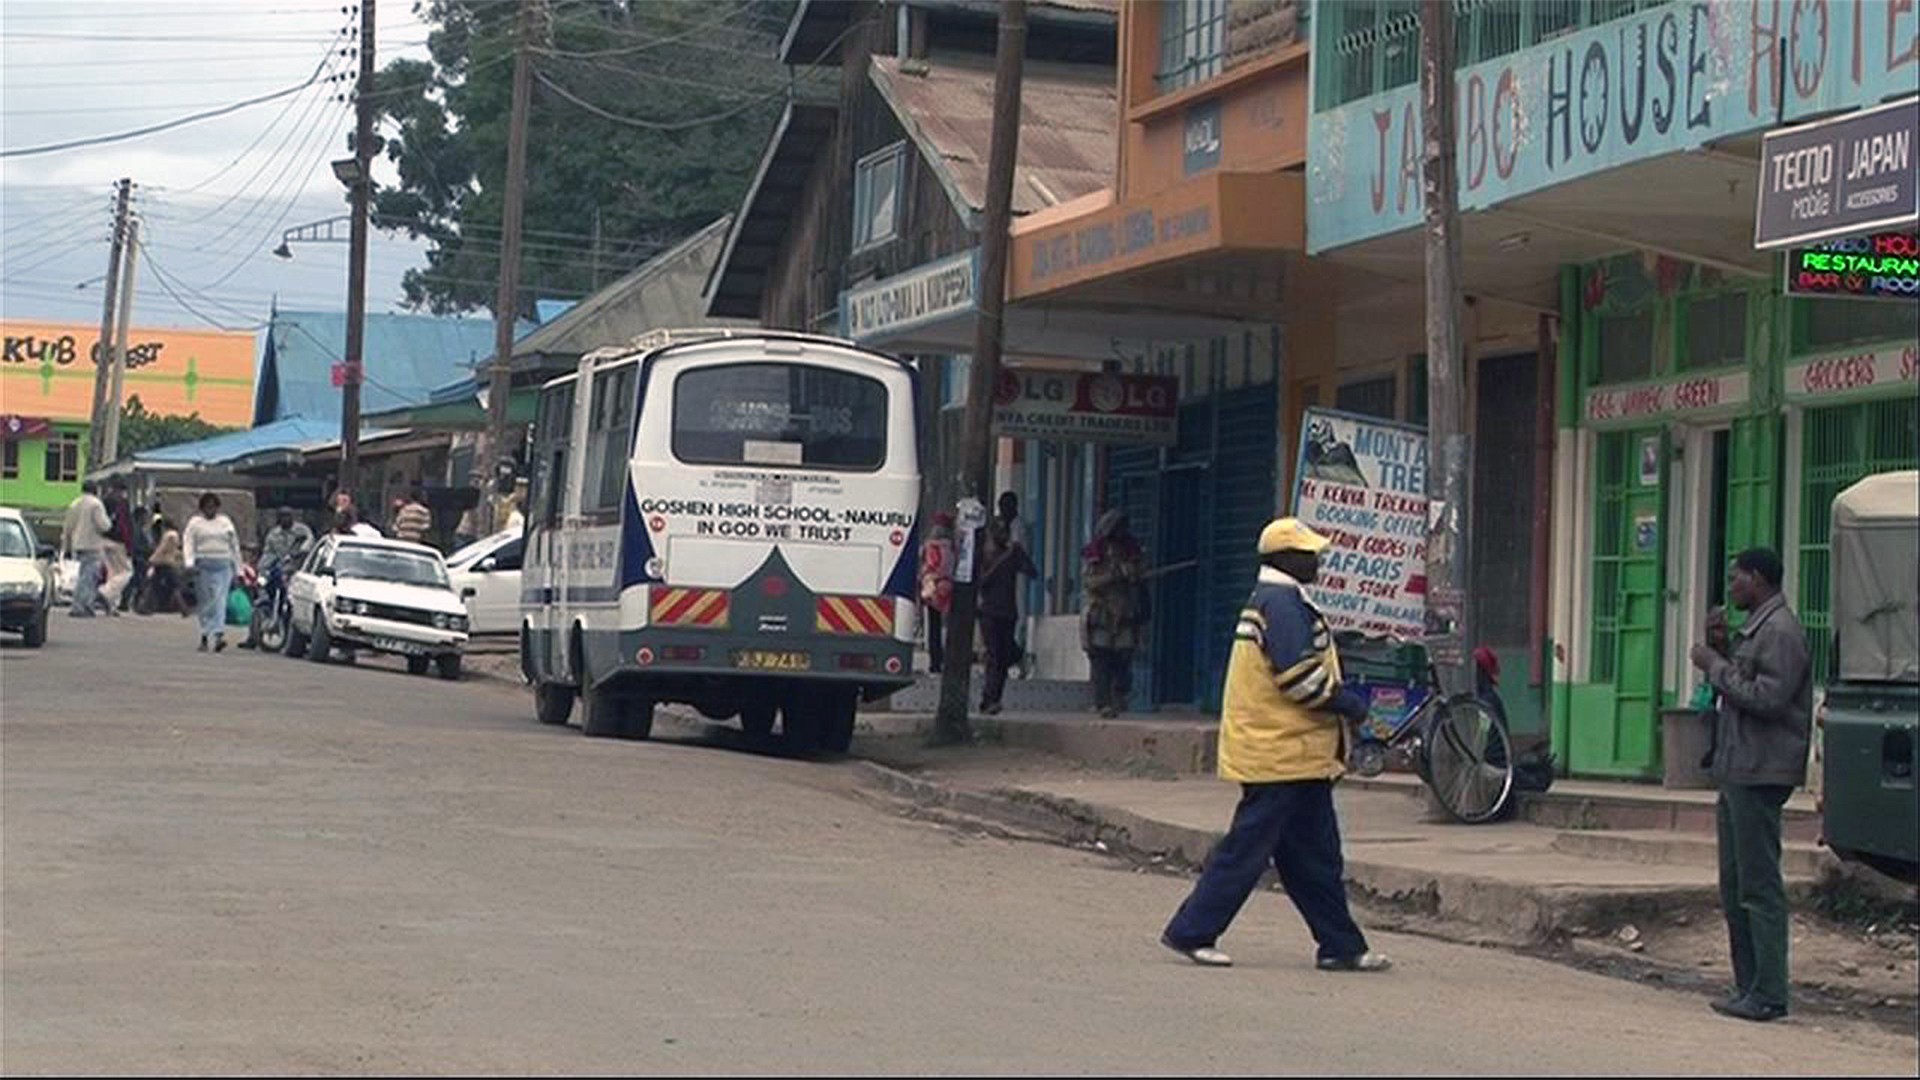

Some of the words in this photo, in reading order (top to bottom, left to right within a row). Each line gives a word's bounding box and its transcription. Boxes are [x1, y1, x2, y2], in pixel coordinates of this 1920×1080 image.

[1370, 67, 1520, 213] JABO
[1547, 4, 1710, 171] HOUSE
[1847, 130, 1909, 180] JAPAN
[1772, 143, 1833, 192] TECNO
[1871, 276, 1918, 292] ROO
[91, 342, 163, 369] EST
[1025, 376, 1064, 400] LG
[1127, 383, 1167, 406] LG
[641, 499, 713, 516] GOSHEN
[718, 502, 758, 518] HIGH
[697, 521, 714, 535] IN
[718, 521, 760, 536] GOD
[765, 523, 791, 538] WE
[799, 524, 852, 541] TRUST
